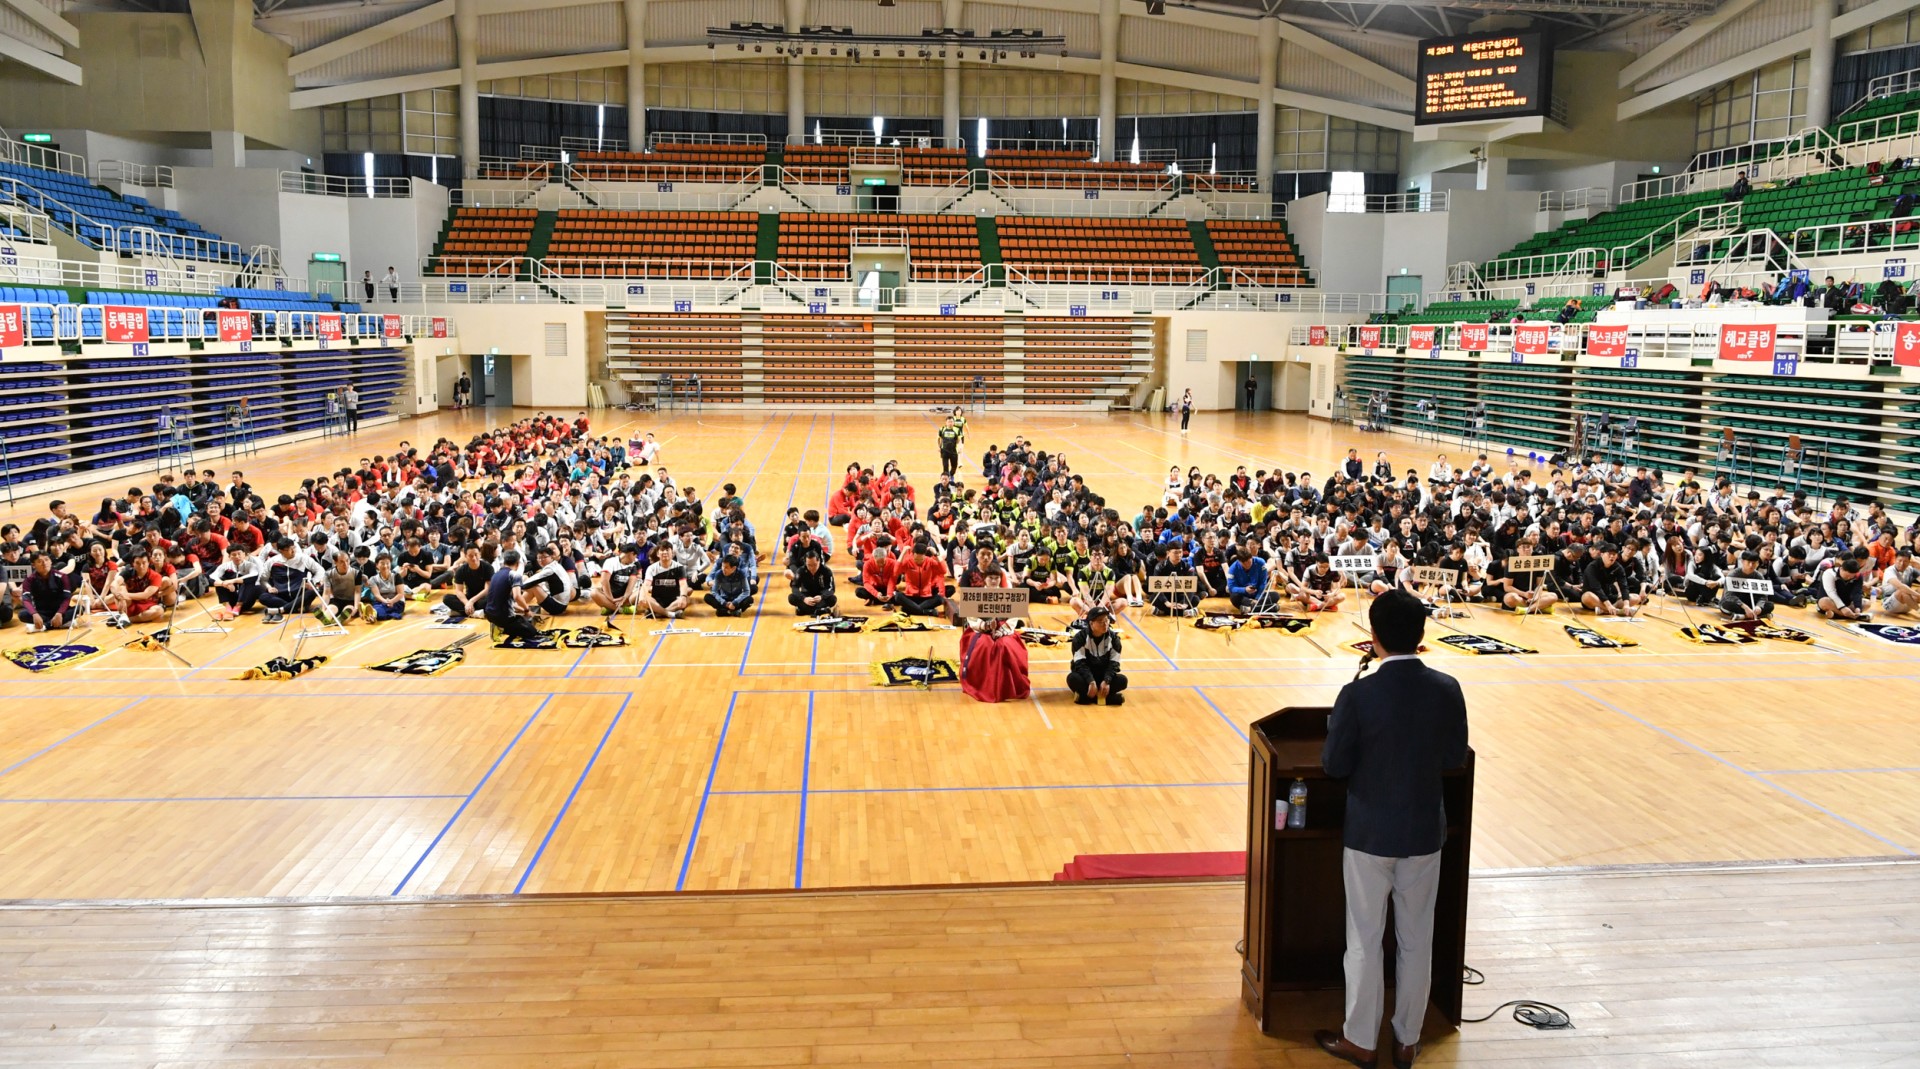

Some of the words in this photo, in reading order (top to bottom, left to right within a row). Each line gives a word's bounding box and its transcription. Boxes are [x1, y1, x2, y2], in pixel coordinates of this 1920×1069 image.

[107, 311, 143, 330] 동백클럽
[221, 315, 248, 331] 삼어클럽
[1463, 328, 1486, 341] 누리클럽
[1517, 330, 1546, 345] 센텀클럽
[1725, 330, 1771, 349] 해교클럽
[1777, 361, 1793, 375] 1-16
[962, 592, 982, 602] 제26회
[983, 592, 1004, 602] 해운대구
[1005, 592, 1027, 602] 구청장기
[977, 603, 1012, 614] 배드민턴대회
